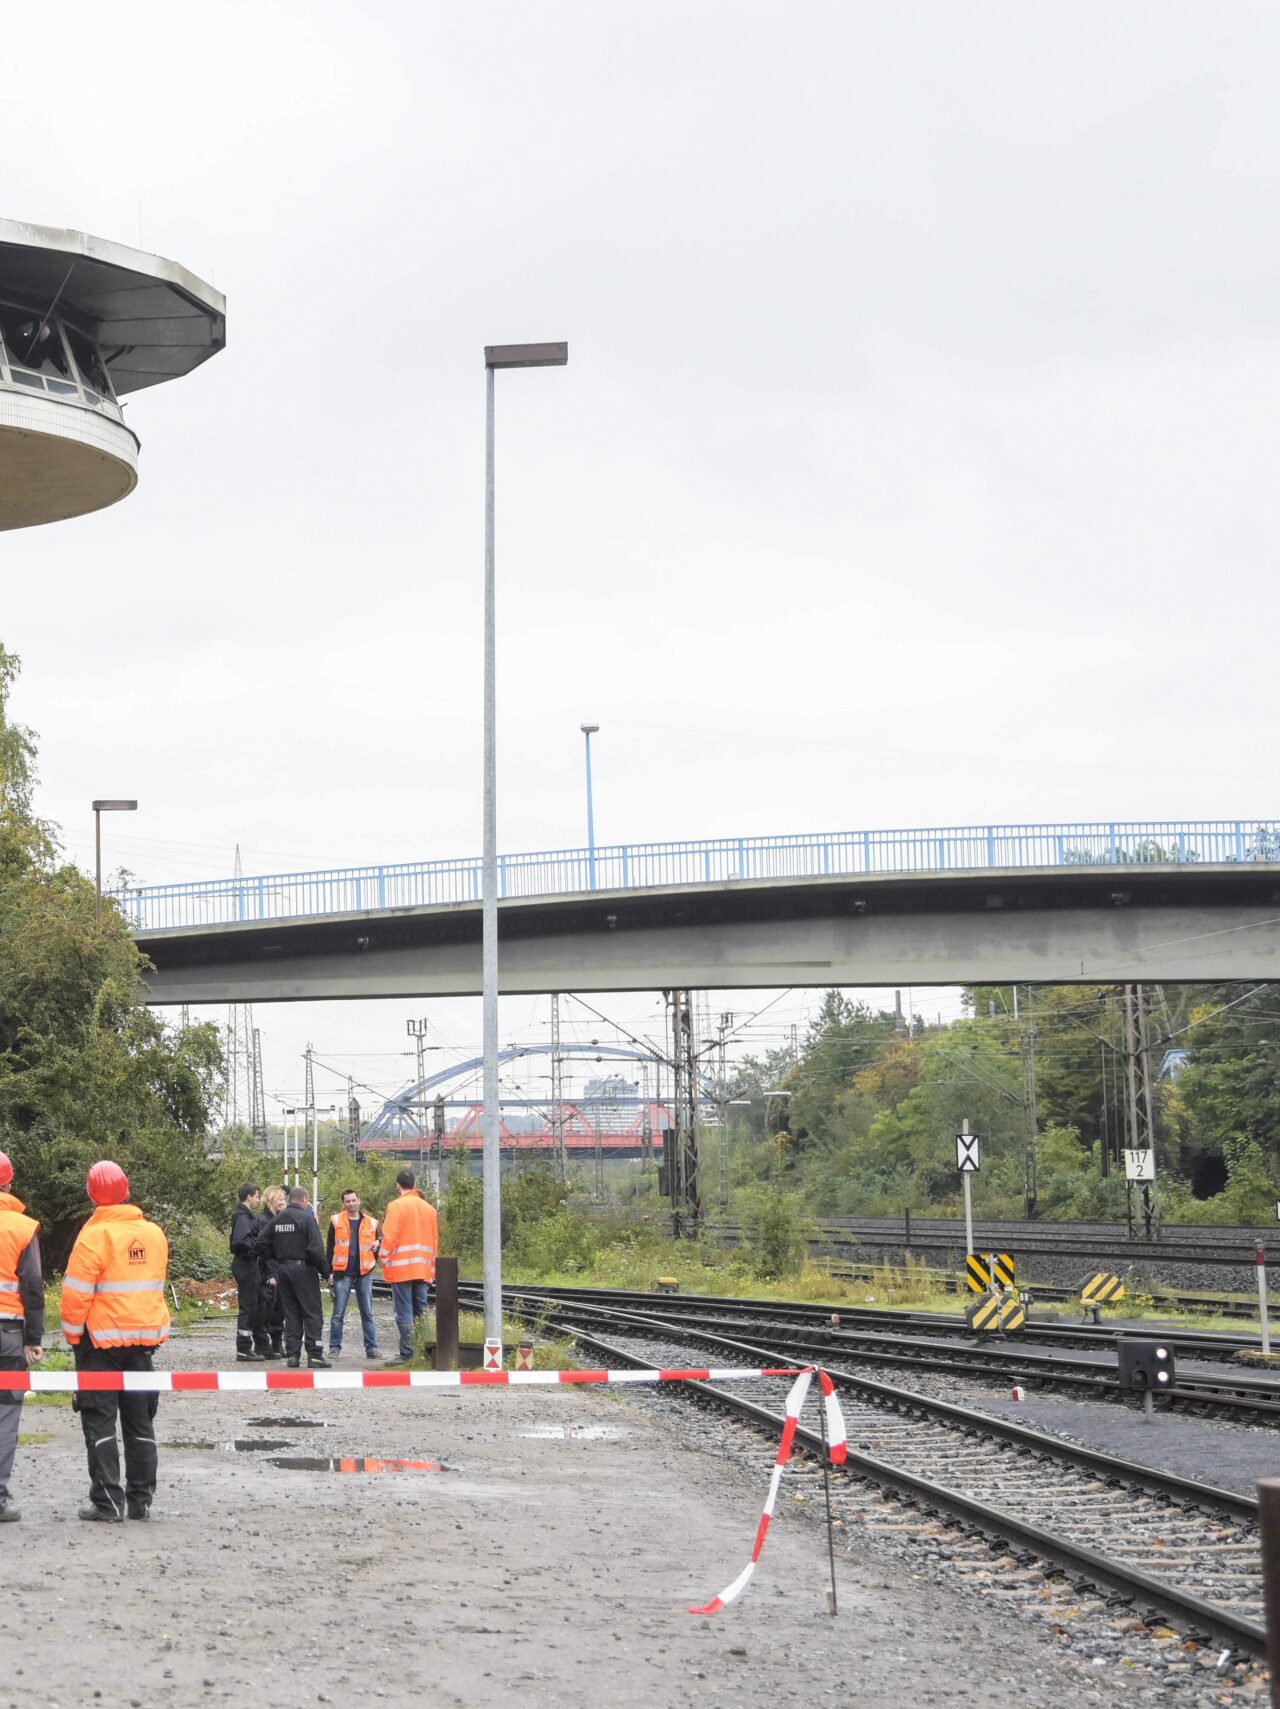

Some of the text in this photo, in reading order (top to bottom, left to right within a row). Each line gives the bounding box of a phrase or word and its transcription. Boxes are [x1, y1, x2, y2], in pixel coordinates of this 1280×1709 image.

[1130, 1151, 1148, 1164] 117
[1136, 1164, 1144, 1177] 2
[275, 1224, 295, 1232] POLIZEI
[129, 1249, 144, 1258] IHT
